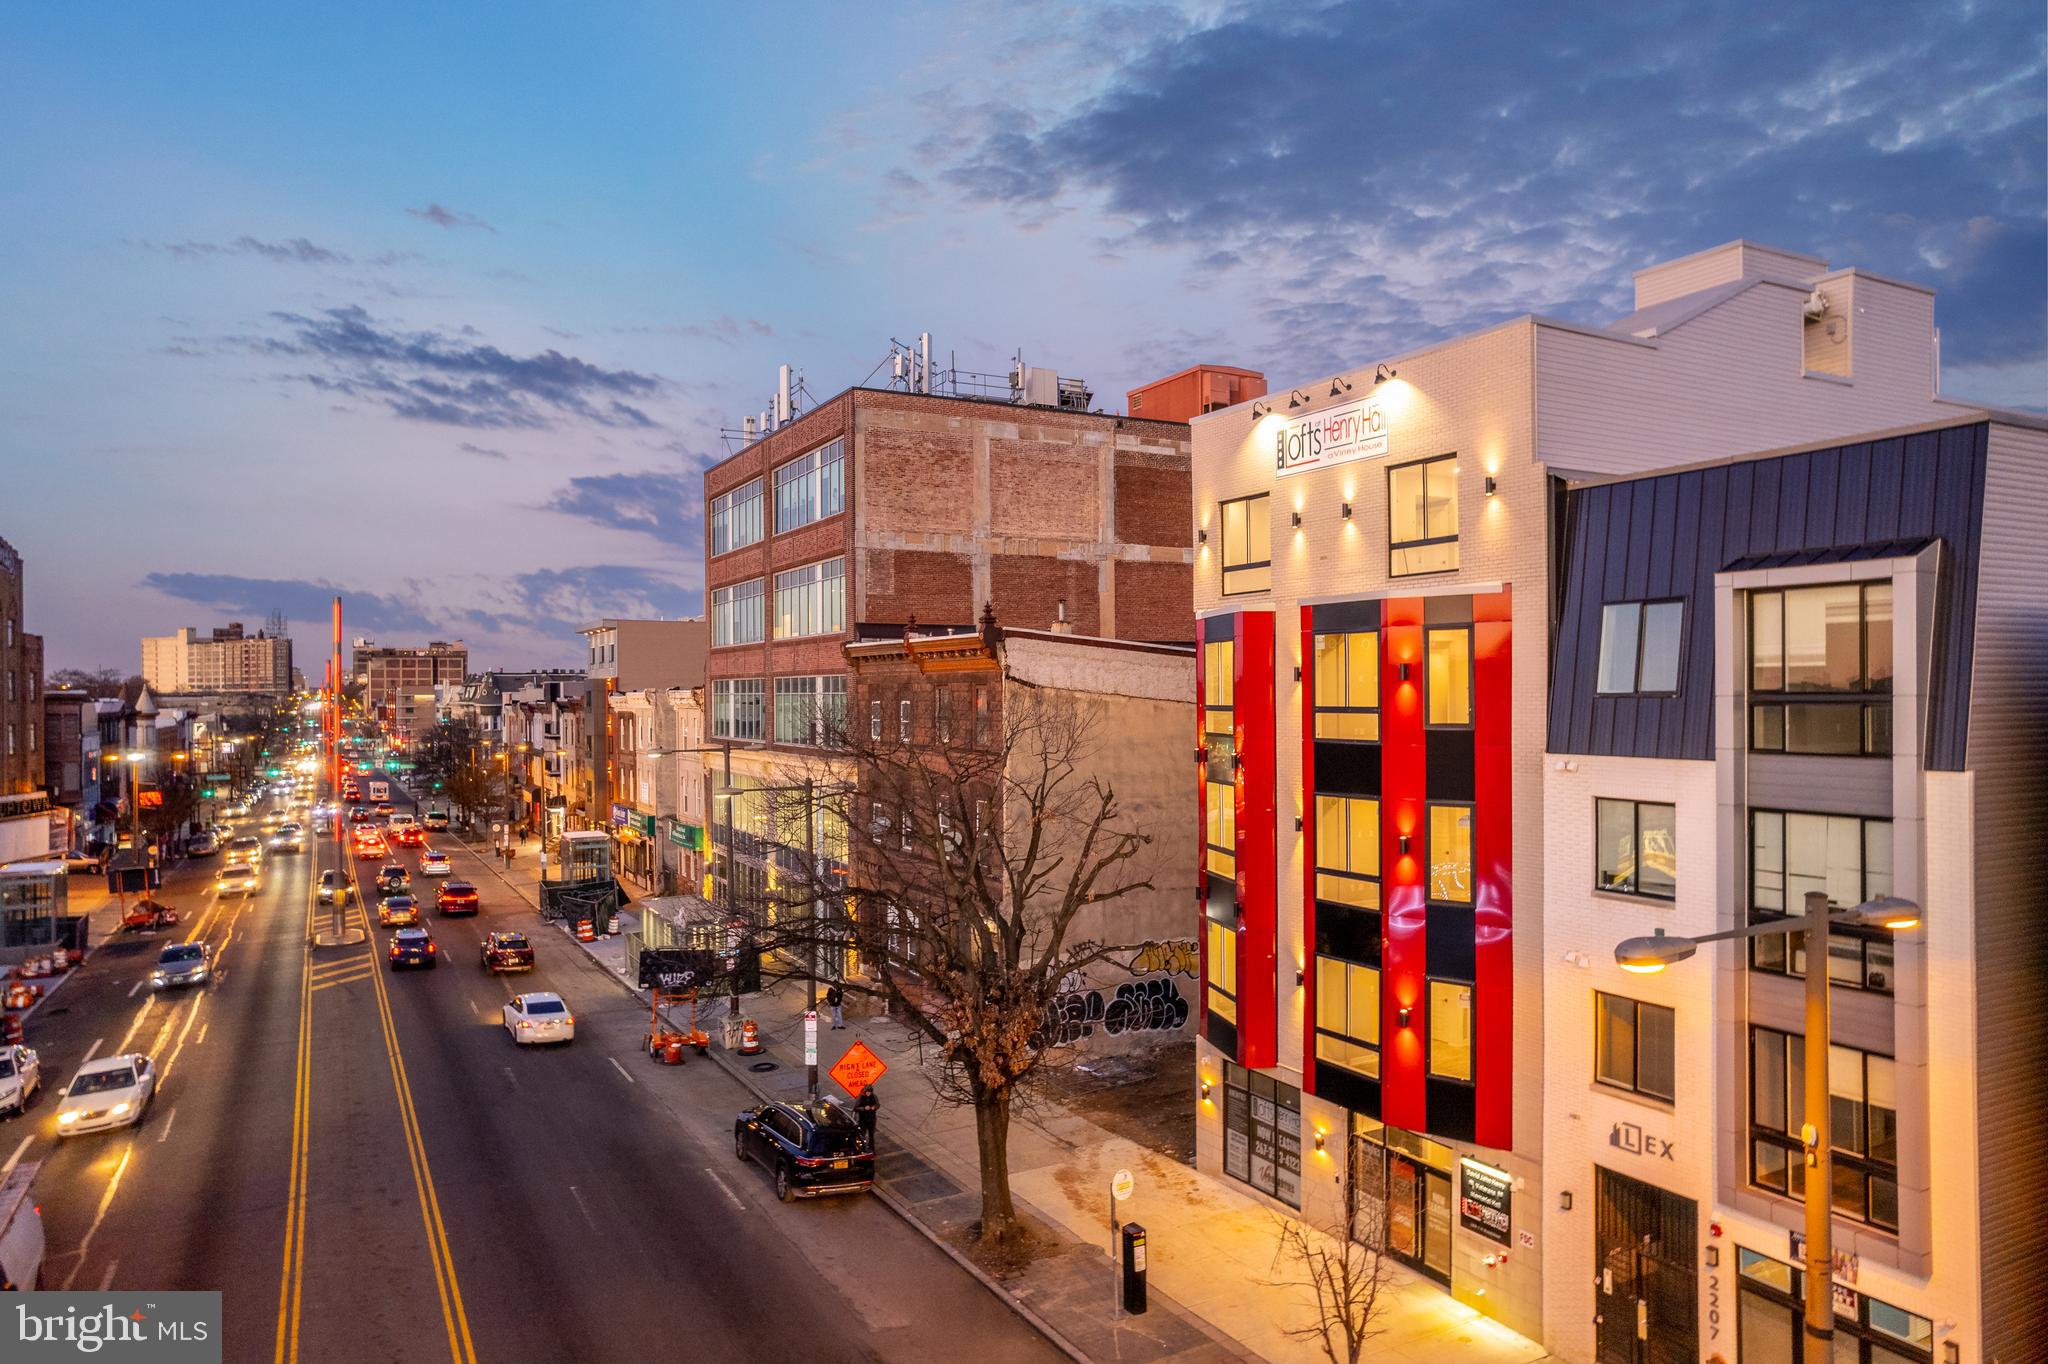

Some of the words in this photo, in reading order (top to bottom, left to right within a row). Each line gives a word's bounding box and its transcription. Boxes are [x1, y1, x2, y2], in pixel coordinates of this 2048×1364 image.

[1323, 416, 1360, 444] Henry
[1334, 446, 1357, 457] Viney
[1358, 441, 1383, 452] House
[847, 1071, 869, 1079] CLOSED
[862, 1061, 876, 1069] LANE
[1624, 1127, 1674, 1162] LEX
[1709, 1275, 1720, 1341] 2207
